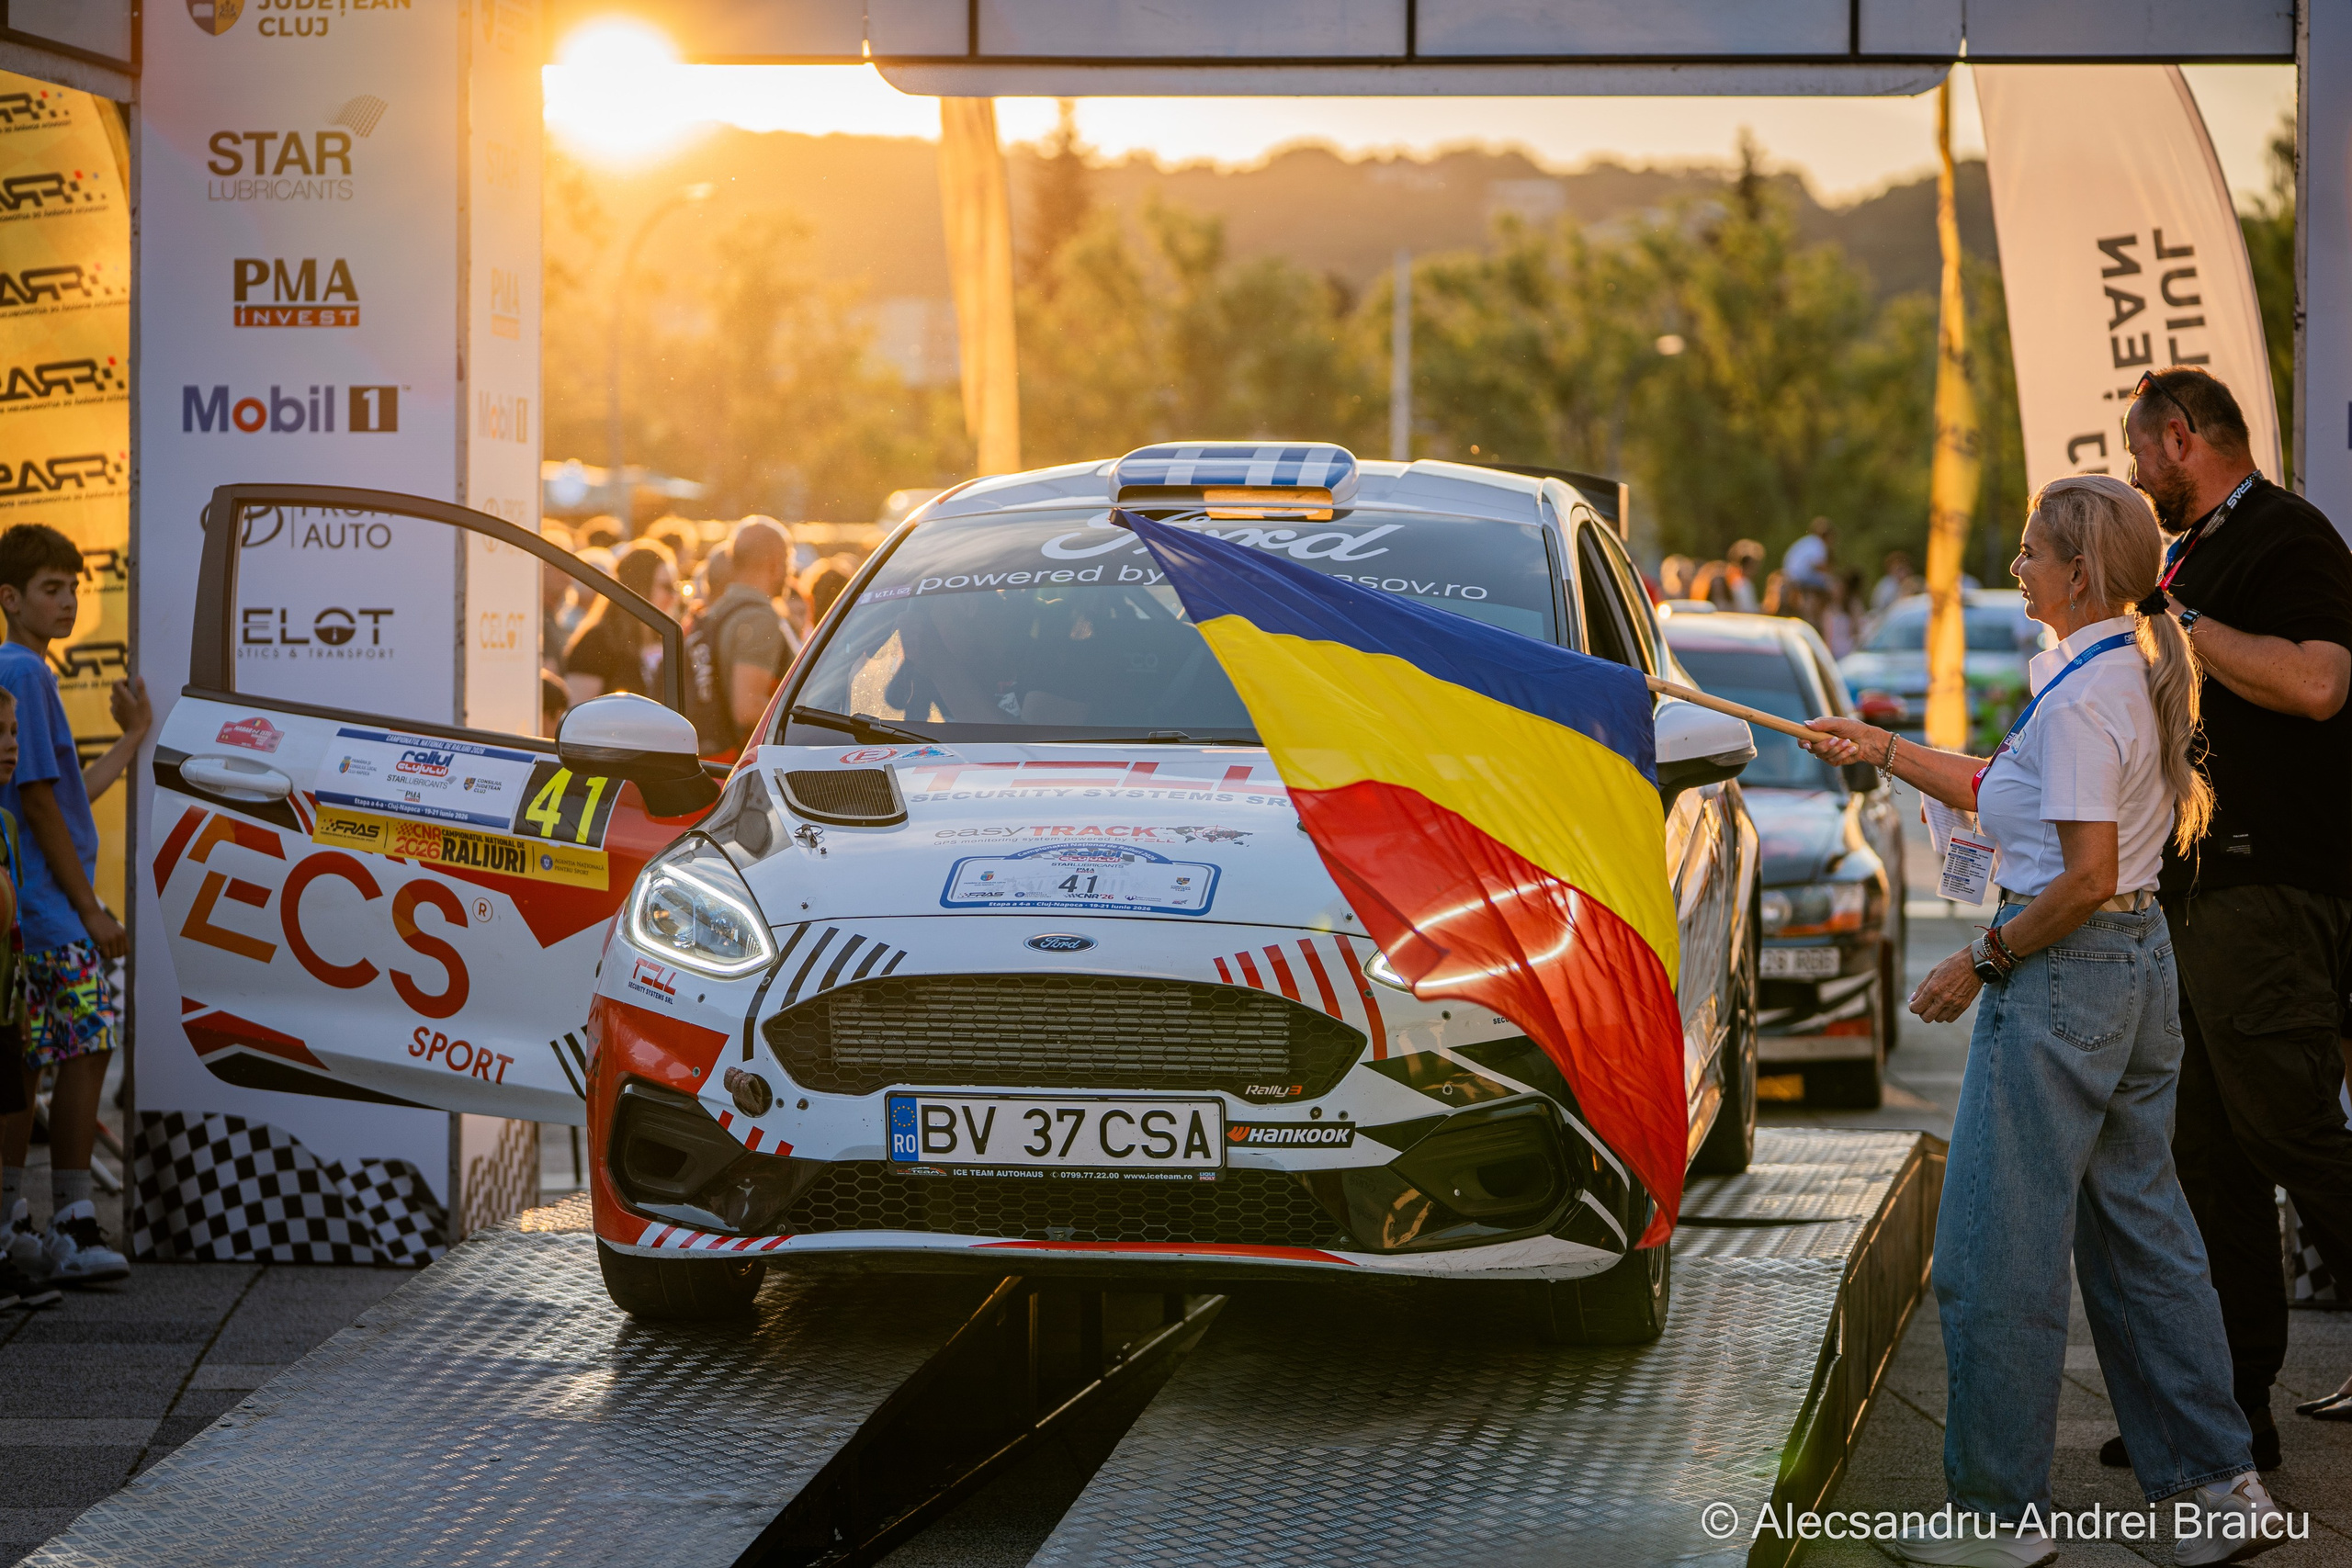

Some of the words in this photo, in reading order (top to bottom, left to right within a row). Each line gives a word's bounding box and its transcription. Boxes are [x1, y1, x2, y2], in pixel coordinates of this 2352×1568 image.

[258, 17, 329, 37] CLUJ
[208, 130, 352, 176] STAR
[208, 178, 354, 201] LUBRICANTS
[233, 258, 358, 302] PMA
[239, 305, 357, 325] INVEST
[183, 385, 334, 434] Mobil
[2227, 478, 2253, 510] FRAS
[302, 523, 391, 549] AUTO
[915, 564, 1104, 595] powered
[1118, 564, 1167, 586] by
[242, 606, 394, 646] ELOT
[237, 647, 279, 660] STICS
[309, 647, 395, 660] TRANSPORT
[386, 734, 419, 746] CAMPIONATUL
[525, 767, 608, 844] 41
[910, 788, 1074, 803] SECURITY
[1083, 788, 1234, 803] SYSTEMS
[354, 797, 370, 807] Etapa
[388, 802, 421, 814] Cluj-Napoca
[424, 807, 438, 816] 19-21
[439, 809, 454, 818] iunie
[455, 811, 468, 820] 2026
[333, 819, 380, 838] FRAS
[413, 823, 441, 841] CNR
[442, 829, 486, 843] CAMPIONATUL
[394, 837, 441, 860] 2026
[441, 837, 526, 874] RALIURI
[1017, 843, 1069, 857] Campionatul
[574, 867, 589, 875] SPORT
[1058, 874, 1099, 893] 41
[1040, 937, 1080, 949] Ford
[628, 981, 645, 994] SECURITY
[645, 988, 664, 1001] SYSTEMS
[664, 995, 673, 1005] SRL
[408, 1025, 514, 1086] SPORT
[1245, 1085, 1303, 1098] Rally3
[922, 1105, 997, 1156] BV
[1023, 1108, 1086, 1157] 37
[1099, 1110, 1212, 1159] CSA
[894, 1134, 916, 1154] RO
[1060, 1171, 1120, 1179] 0799.77.22.00
[1123, 1172, 1193, 1180] www.iceteam.ro
